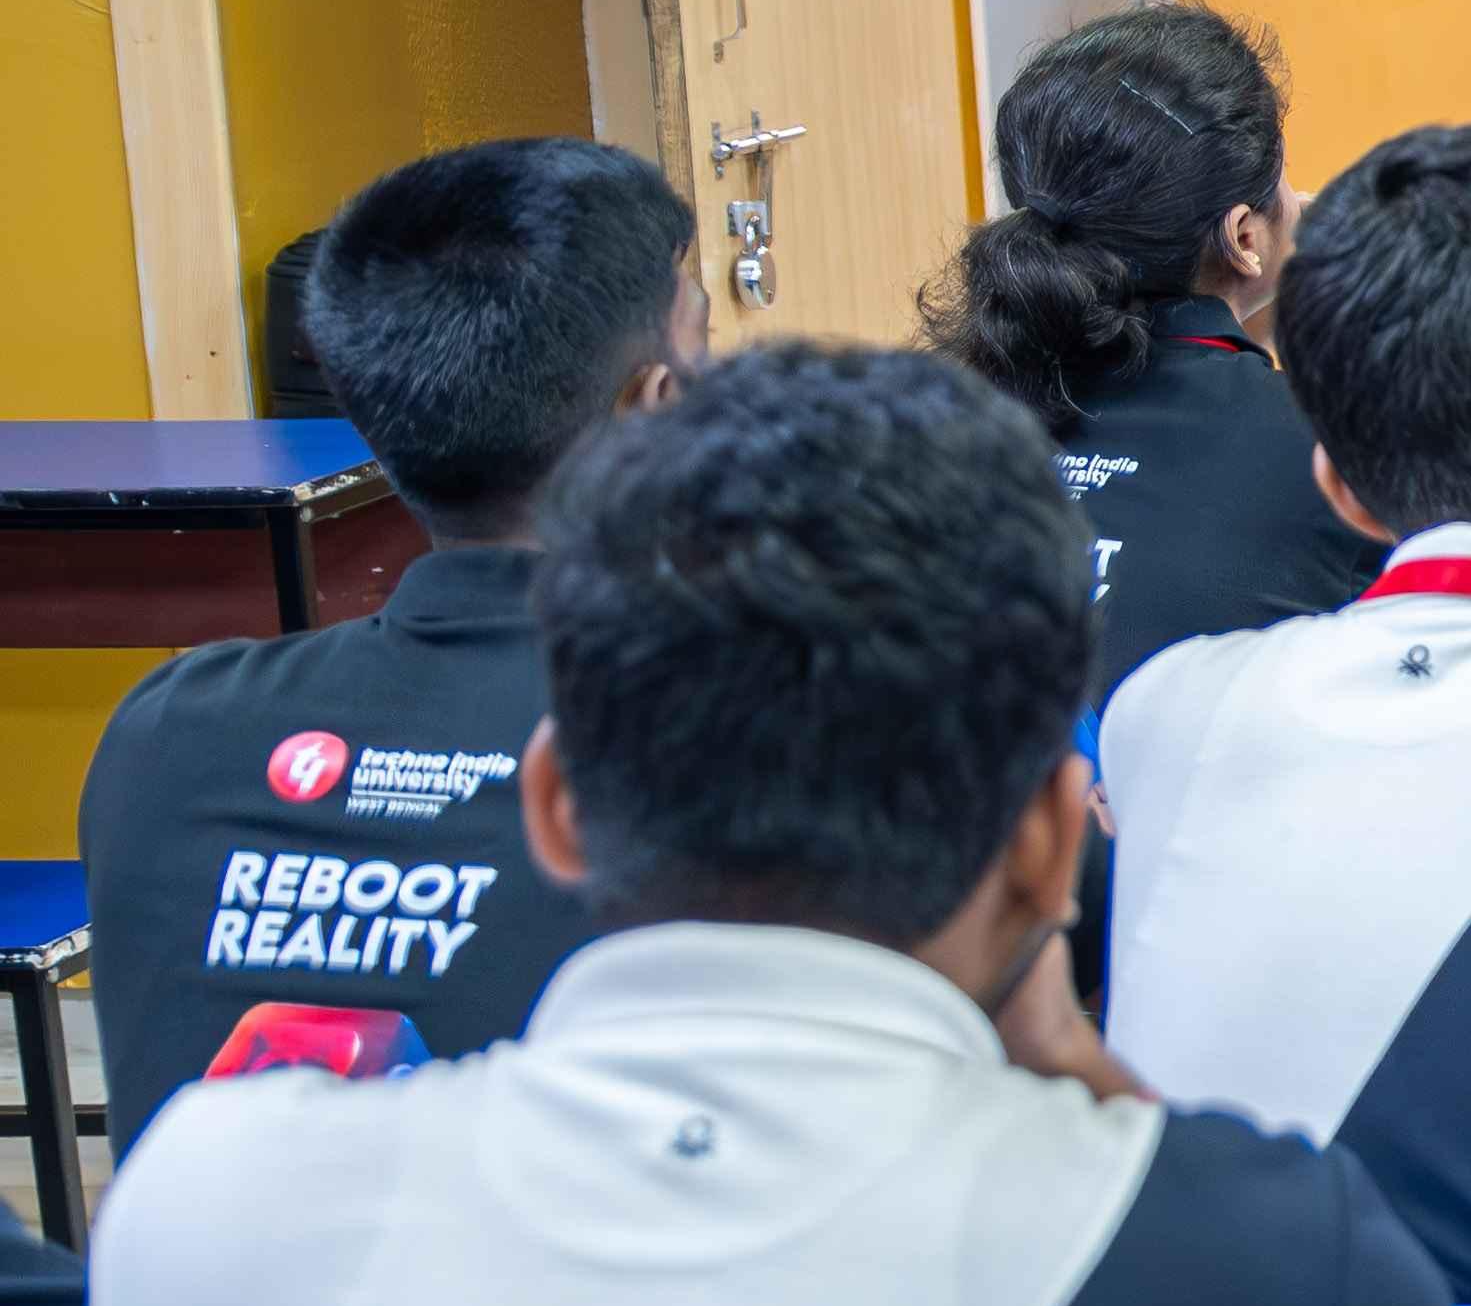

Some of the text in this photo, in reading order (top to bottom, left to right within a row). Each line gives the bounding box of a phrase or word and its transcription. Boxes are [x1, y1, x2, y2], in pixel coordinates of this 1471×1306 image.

[360, 748, 450, 772] techno
[351, 766, 482, 802] university
[346, 796, 443, 820] WEST BENGAL
[220, 851, 499, 918] REBOOT
[206, 909, 479, 978] REALITY
